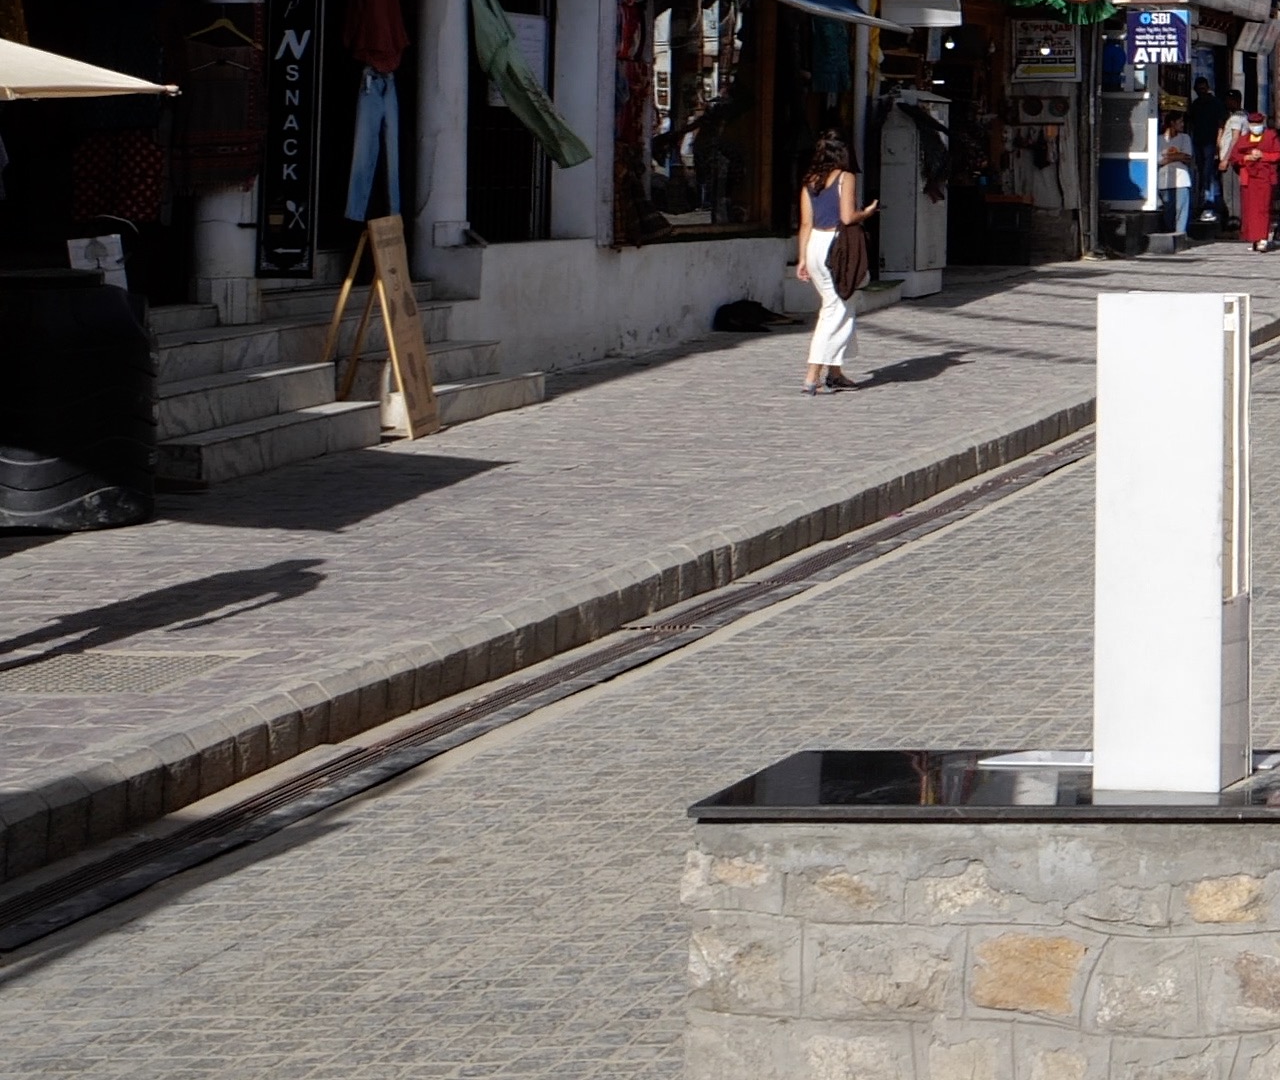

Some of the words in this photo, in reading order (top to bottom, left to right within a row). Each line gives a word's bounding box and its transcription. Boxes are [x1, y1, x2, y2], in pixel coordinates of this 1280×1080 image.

[1150, 12, 1171, 25] SBI
[1018, 49, 1073, 57] RESTRANT
[1133, 47, 1178, 63] ATM
[281, 64, 301, 182] SNACK
[1094, 291, 1254, 795] I
